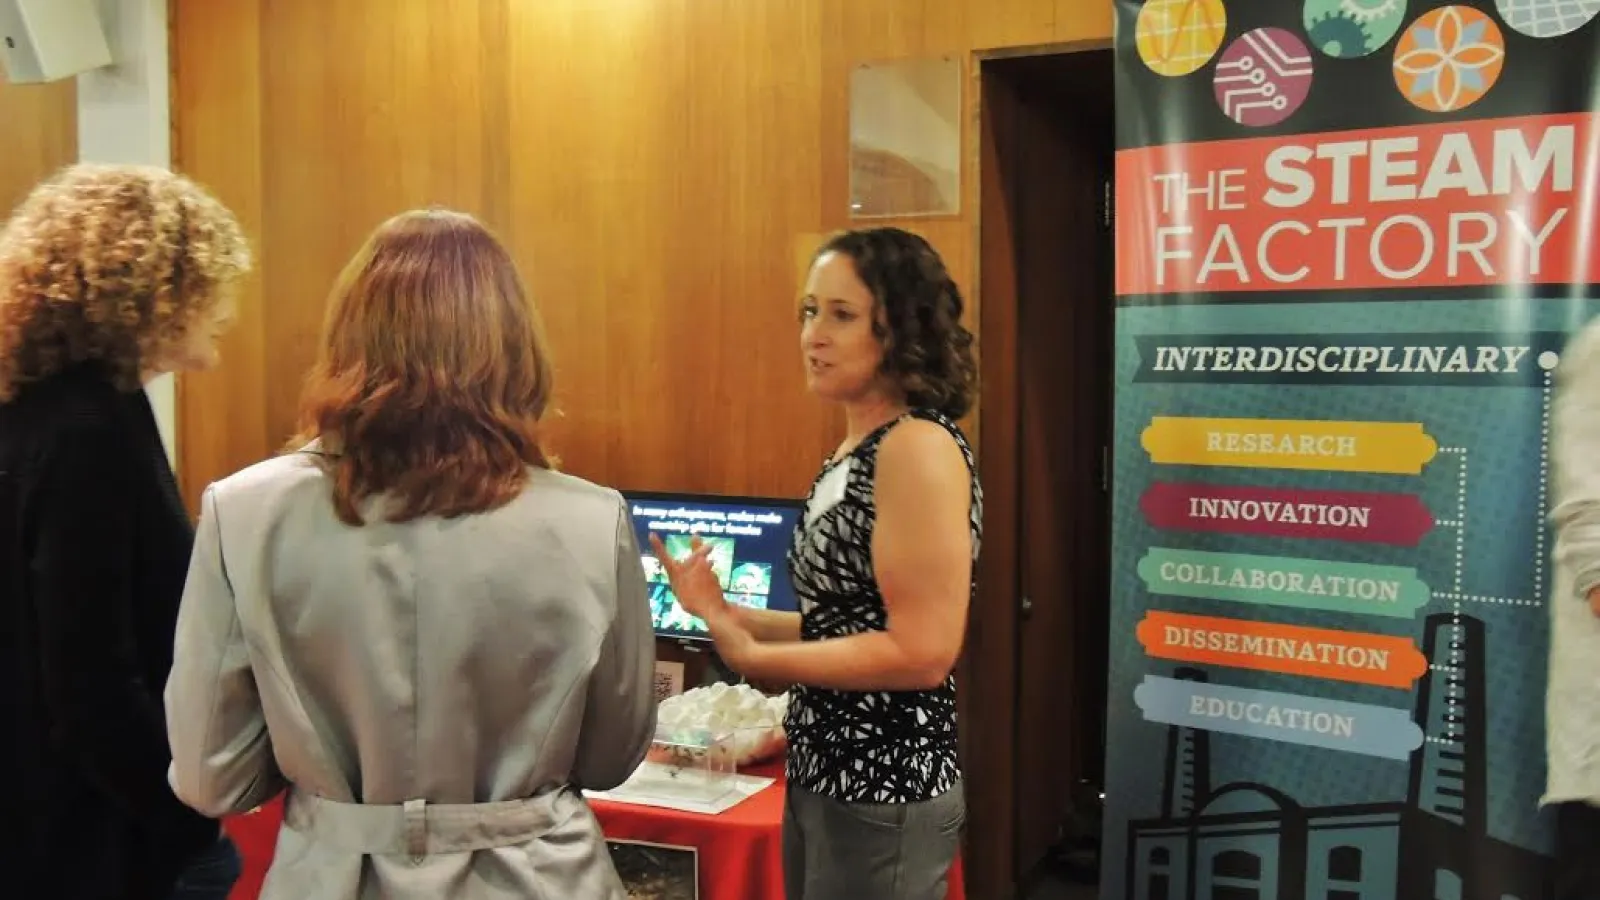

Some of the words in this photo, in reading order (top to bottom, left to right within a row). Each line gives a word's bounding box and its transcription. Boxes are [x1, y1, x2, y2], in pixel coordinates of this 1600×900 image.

[1153, 169, 1247, 214] THE
[1263, 125, 1575, 208] STEAM
[1155, 208, 1568, 285] FACTORY
[1153, 346, 1530, 374] INTERDISCIPLINARY
[1206, 432, 1357, 457] RESEARCH
[1189, 497, 1371, 528] INNOVATION
[1159, 561, 1401, 602] COLLABORATION
[1164, 626, 1391, 671] DISSEMINATION
[1189, 695, 1357, 738] EDUCATION
